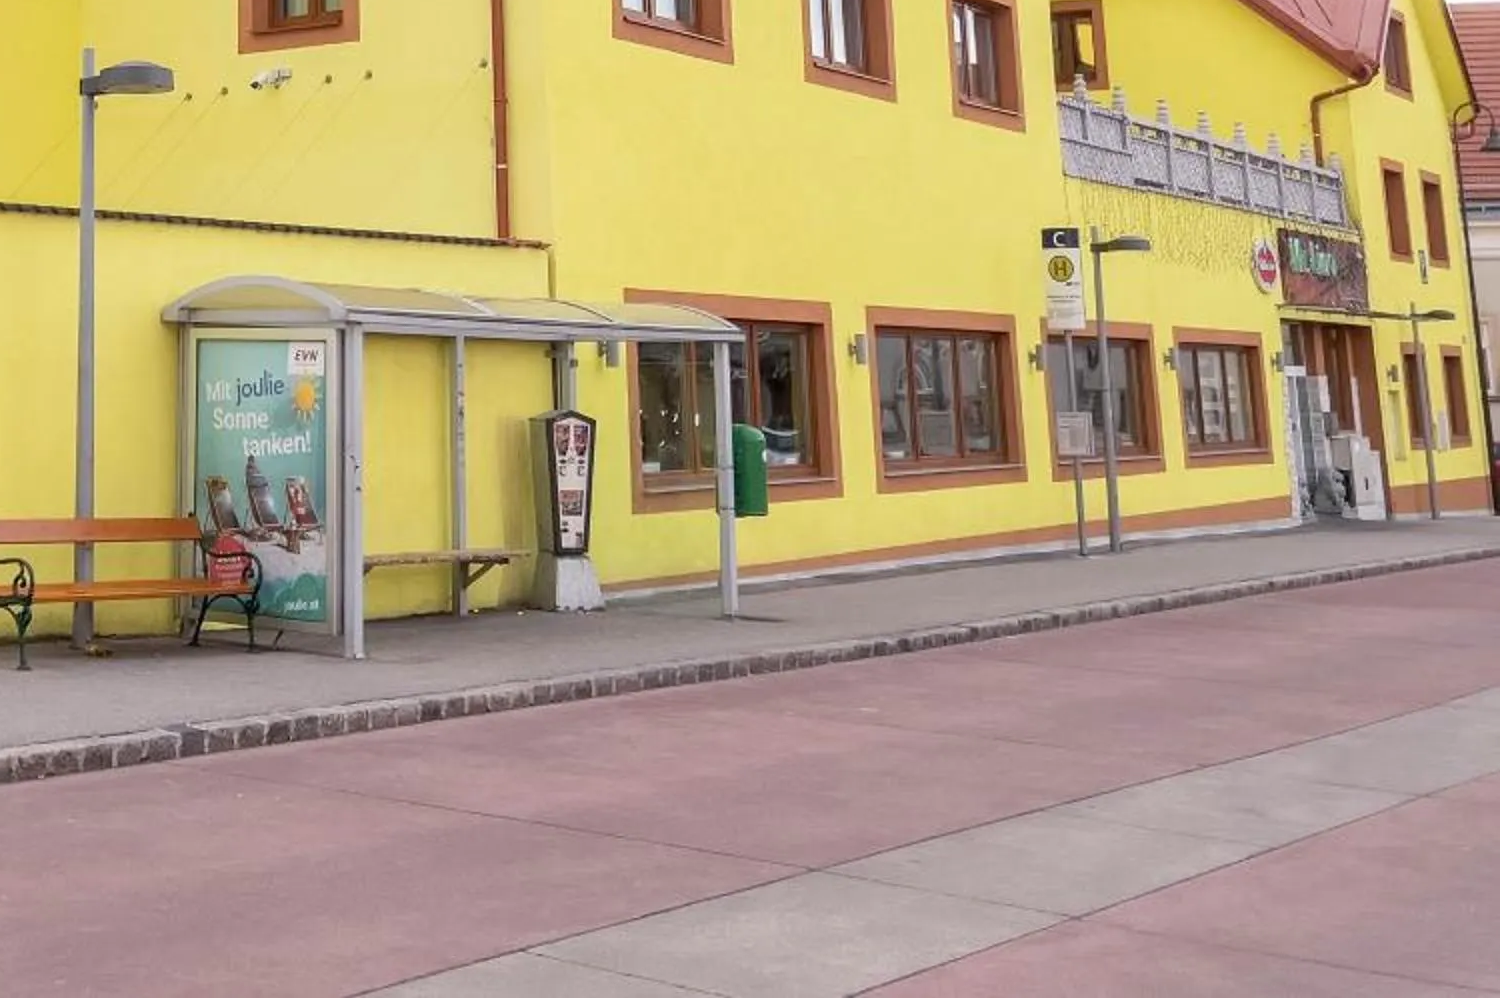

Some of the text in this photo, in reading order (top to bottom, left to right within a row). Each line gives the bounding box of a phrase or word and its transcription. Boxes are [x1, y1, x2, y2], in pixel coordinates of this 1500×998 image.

[1053, 231, 1067, 247] C
[1053, 260, 1068, 277] H
[294, 349, 319, 362] EVN
[205, 369, 285, 406] Mit joulie
[213, 407, 269, 430] Sonne
[243, 430, 313, 457] tanken!
